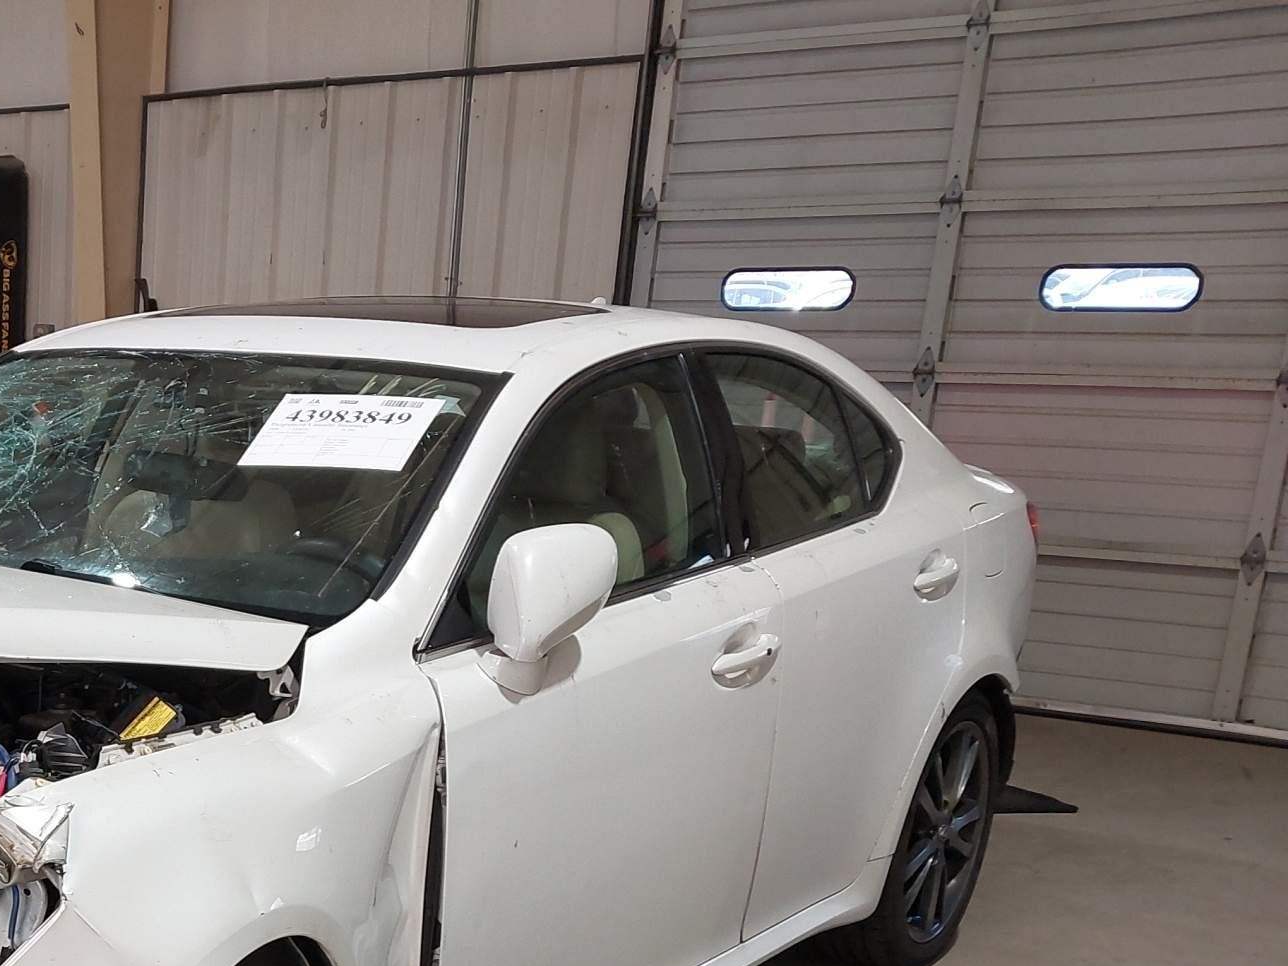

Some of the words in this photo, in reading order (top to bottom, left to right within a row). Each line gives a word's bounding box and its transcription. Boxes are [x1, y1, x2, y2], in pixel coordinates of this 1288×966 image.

[2, 268, 10, 292] BIG
[2, 293, 10, 321] ASS
[286, 409, 412, 425] 43983849
